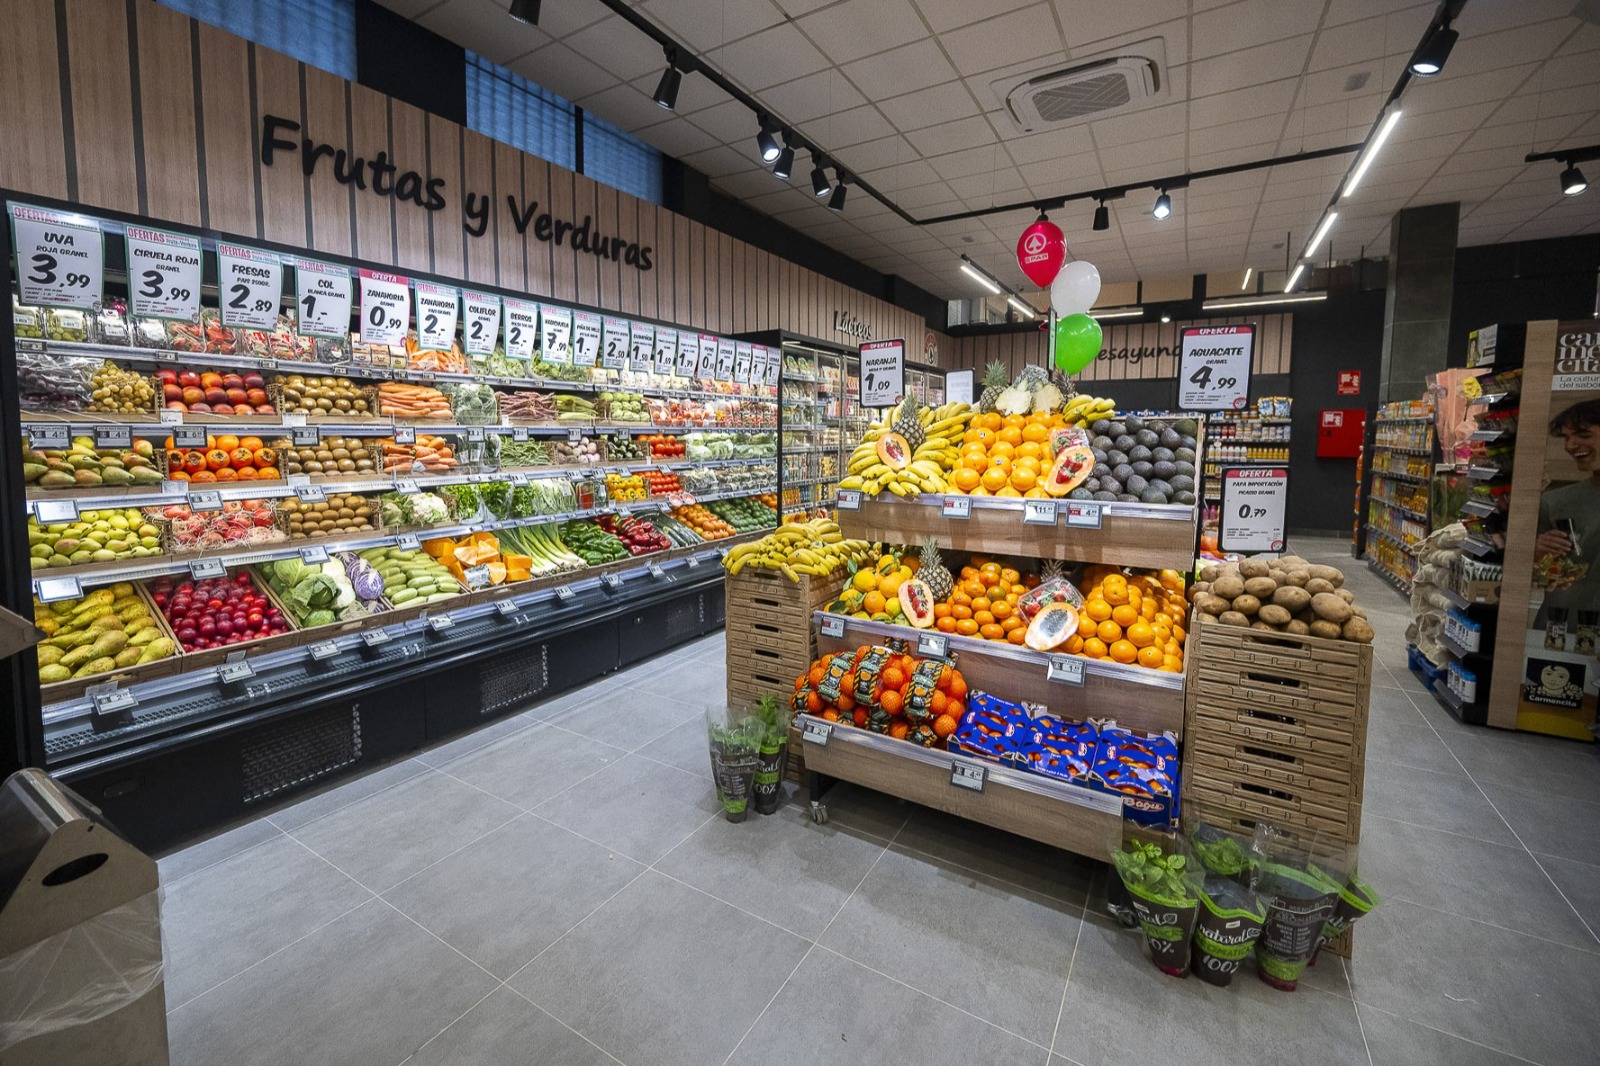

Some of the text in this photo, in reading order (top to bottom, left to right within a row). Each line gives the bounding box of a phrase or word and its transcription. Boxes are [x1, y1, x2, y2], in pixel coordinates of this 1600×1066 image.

[261, 114, 653, 271] Frutas y Verduras
[44, 231, 74, 246] UVA
[128, 228, 165, 243] OFERTAS
[36, 245, 89, 258] ROJA GRANEL
[134, 248, 198, 266] CIRUELA ROJA
[220, 244, 251, 258] OFERTAS
[1026, 254, 1048, 263] SPAR
[27, 253, 91, 288] 3,99
[156, 264, 180, 273] GRANEL
[232, 264, 270, 278] FRESAS
[298, 260, 324, 272] OFERTAS
[318, 279, 334, 289] COL
[372, 272, 397, 283] OFERTA
[138, 270, 190, 301] 3,99
[228, 284, 272, 312] 2,89
[367, 289, 404, 302] ZANAHORIA
[420, 298, 455, 310] ZANAHORIA
[468, 305, 496, 316] COLIFLOR
[370, 306, 402, 329] 0,99
[510, 313, 532, 322] BERROS
[834, 311, 872, 340] Lácteos
[1200, 327, 1237, 335] OFERTA
[547, 332, 566, 352] 7,99
[870, 342, 893, 350] OFERTA
[607, 341, 624, 358] 2,50
[1098, 345, 1181, 364] esayuno
[1189, 347, 1244, 357] AGUACATE
[866, 357, 897, 366] NARANJA
[865, 372, 890, 392] 1,09
[1190, 366, 1236, 390] 4,99
[1239, 470, 1273, 478] OFERTA
[1238, 504, 1266, 518] 0,79
[1200, 924, 1246, 944] natural
